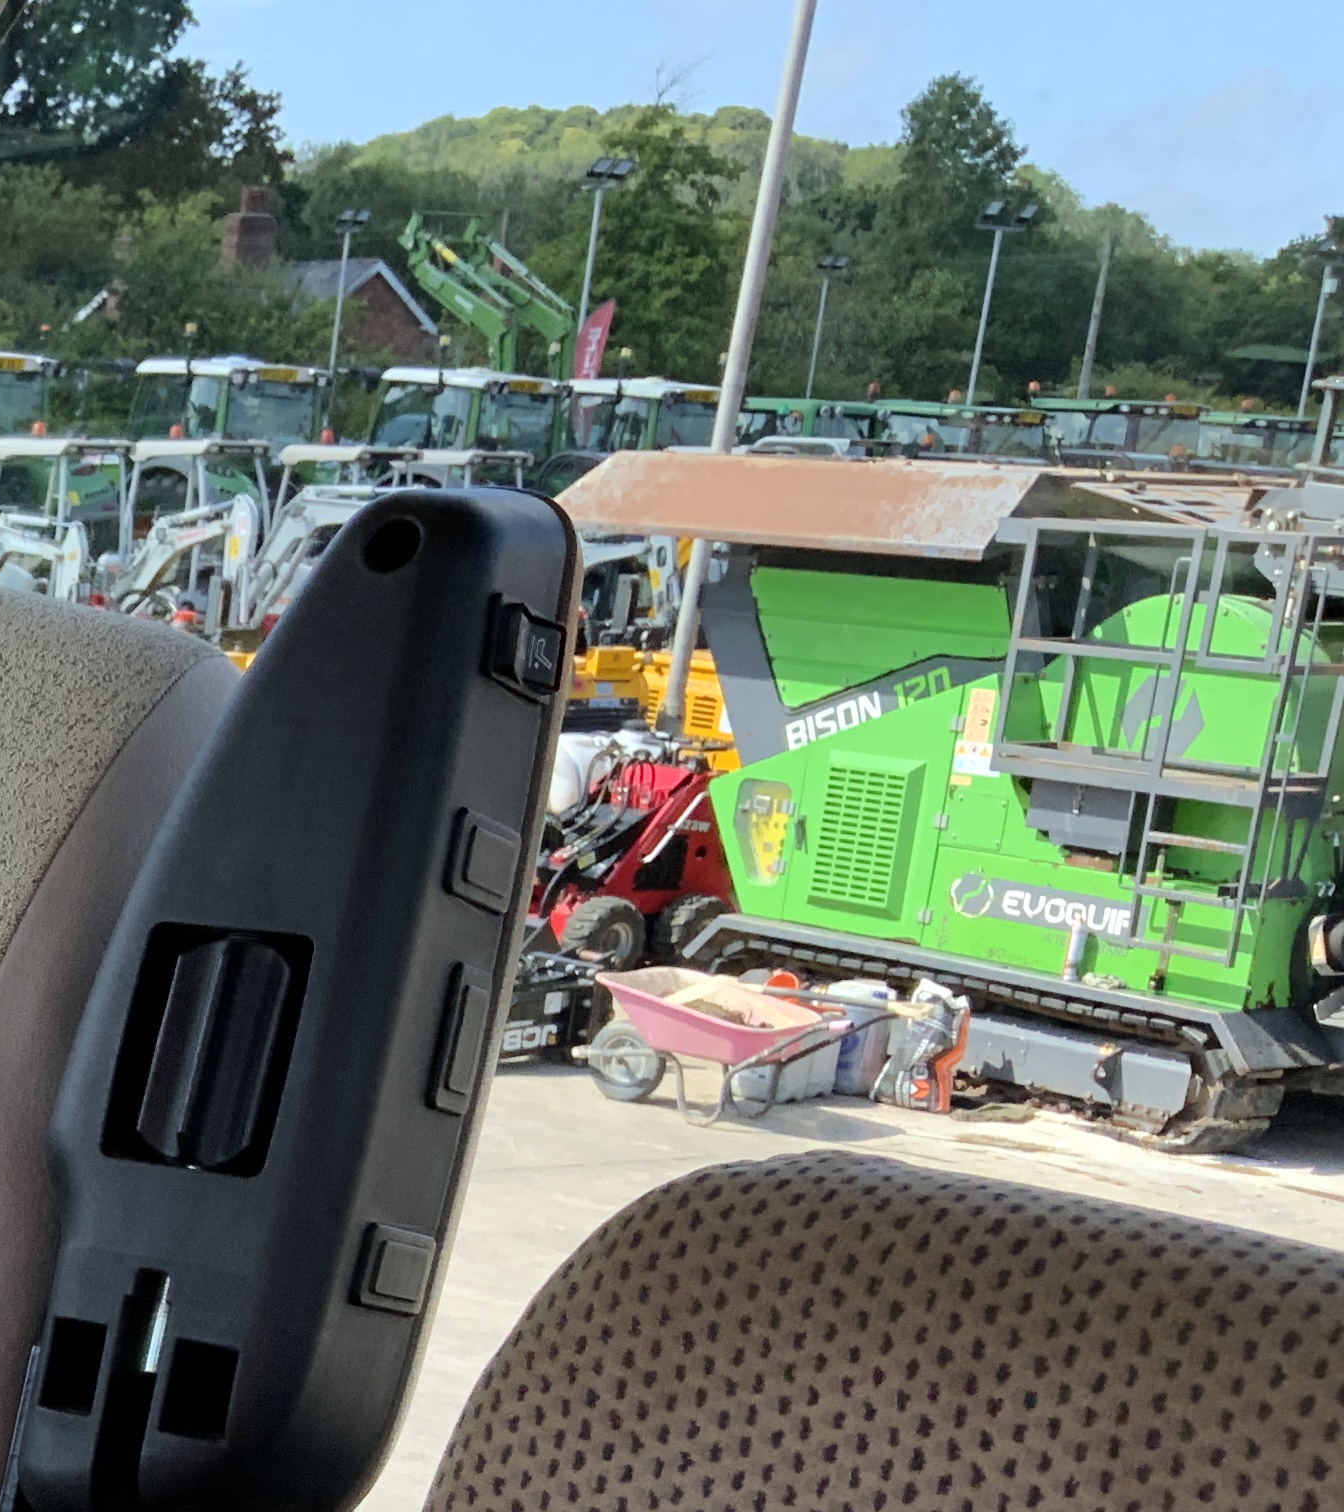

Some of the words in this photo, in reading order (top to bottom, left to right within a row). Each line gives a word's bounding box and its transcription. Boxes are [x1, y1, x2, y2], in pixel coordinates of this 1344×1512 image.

[786, 690, 882, 752] BISON
[893, 666, 953, 710] 120
[503, 1023, 558, 1052] JCB
